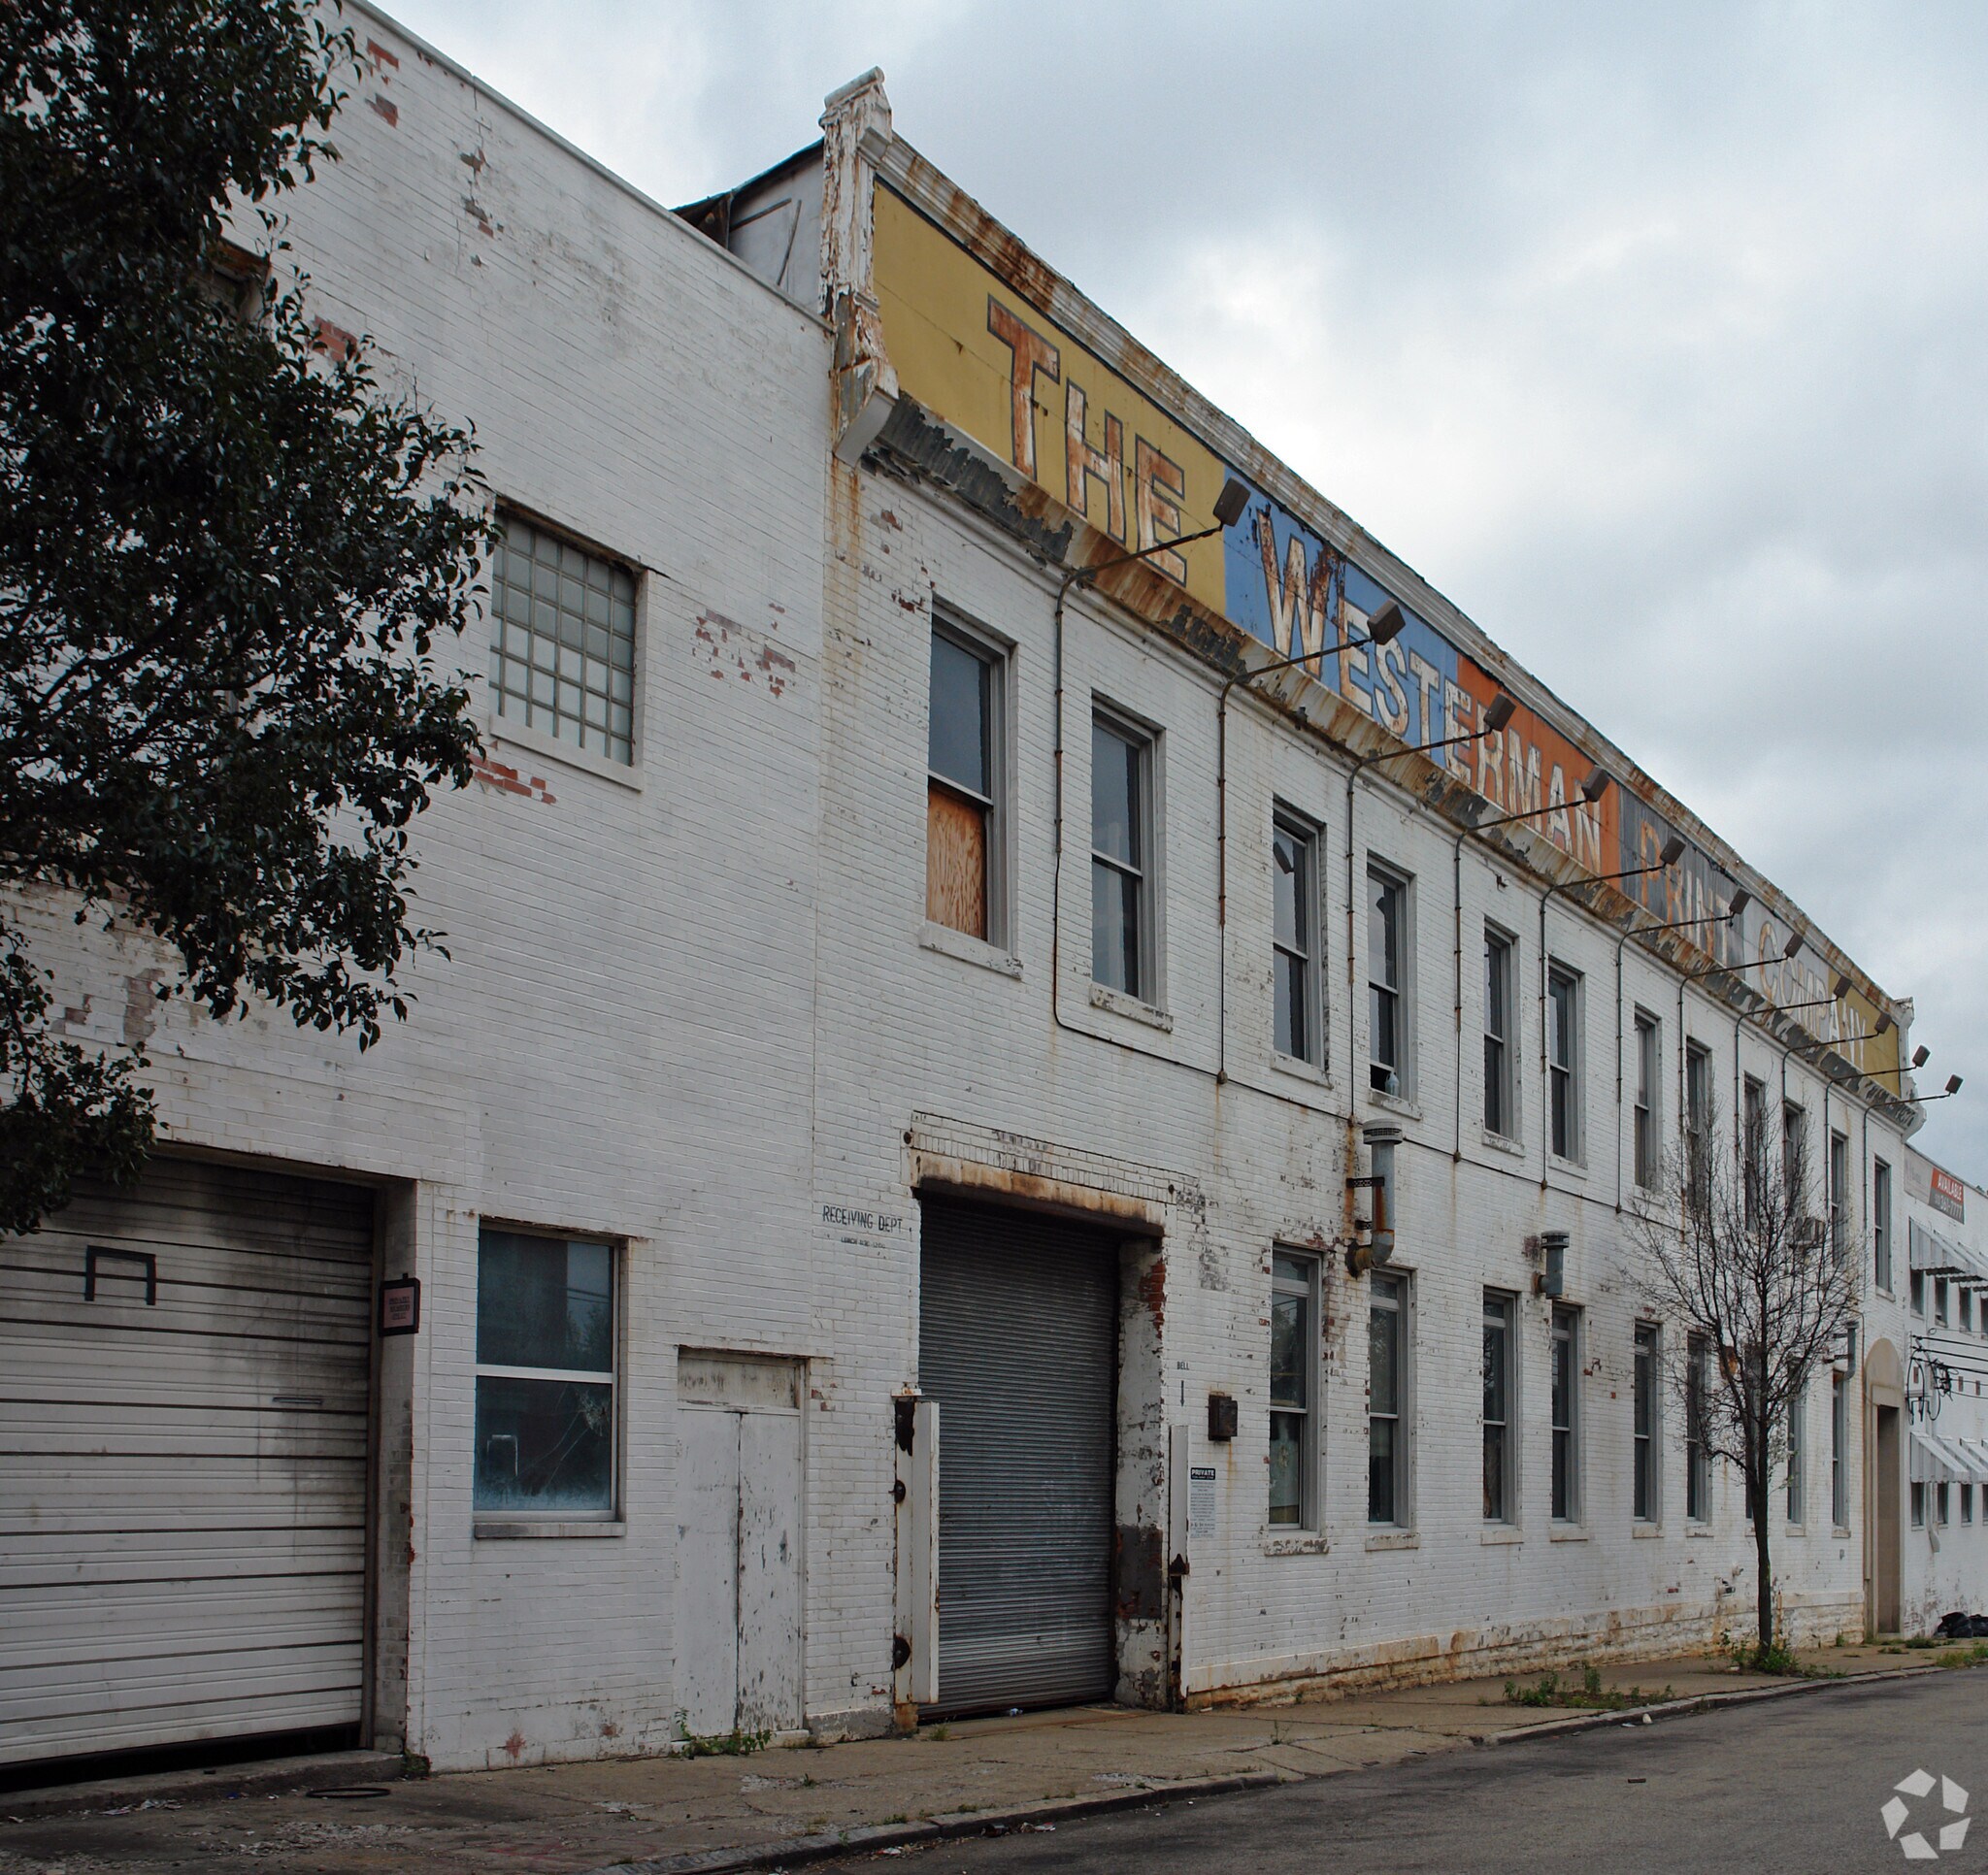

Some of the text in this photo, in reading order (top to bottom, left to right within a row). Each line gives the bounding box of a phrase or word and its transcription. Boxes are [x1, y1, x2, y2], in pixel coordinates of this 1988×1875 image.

[987, 293, 1867, 1072] THE WESTERMAN PRINT COMPANY
[822, 1204, 874, 1230] RECEIVING
[1176, 1361, 1189, 1370] BELL
